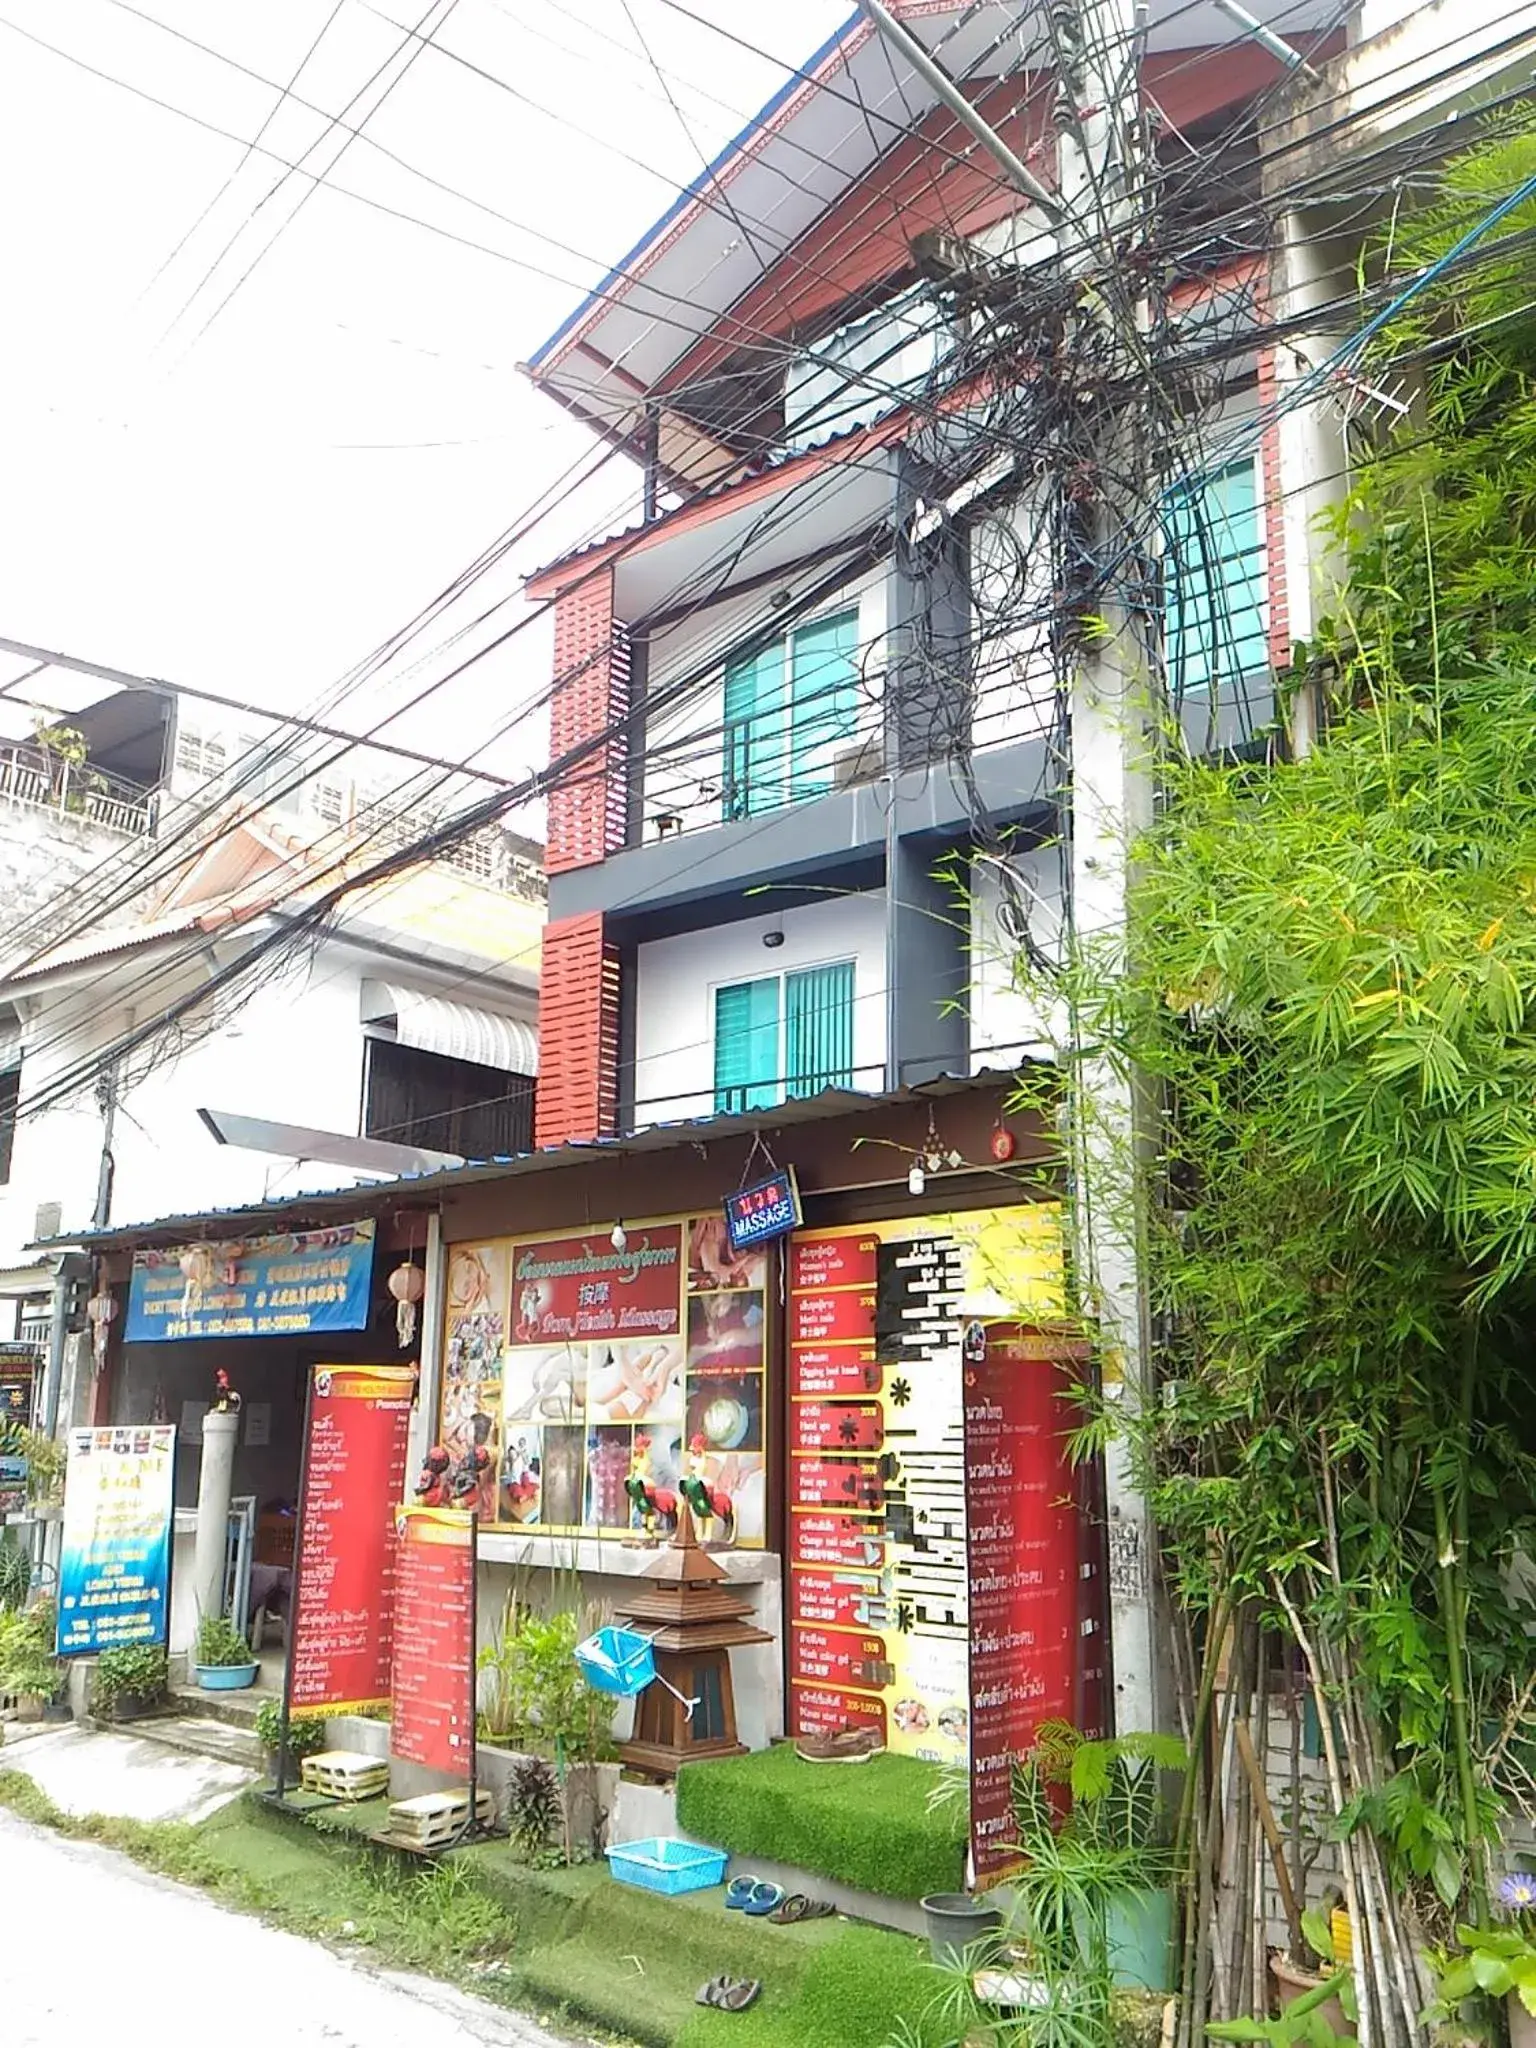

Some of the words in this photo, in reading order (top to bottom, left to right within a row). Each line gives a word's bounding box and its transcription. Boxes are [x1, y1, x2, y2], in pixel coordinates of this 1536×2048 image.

[739, 1187, 779, 1215] นวด
[734, 1200, 791, 1236] MASSAGE
[578, 1281, 611, 1306] 按摩
[618, 1307, 677, 1330] Massage
[966, 1397, 1003, 1421] นวดไทย
[968, 1448, 1013, 1479] นวดน้ำมัน
[970, 1511, 1015, 1541] นวดน้ำมัน
